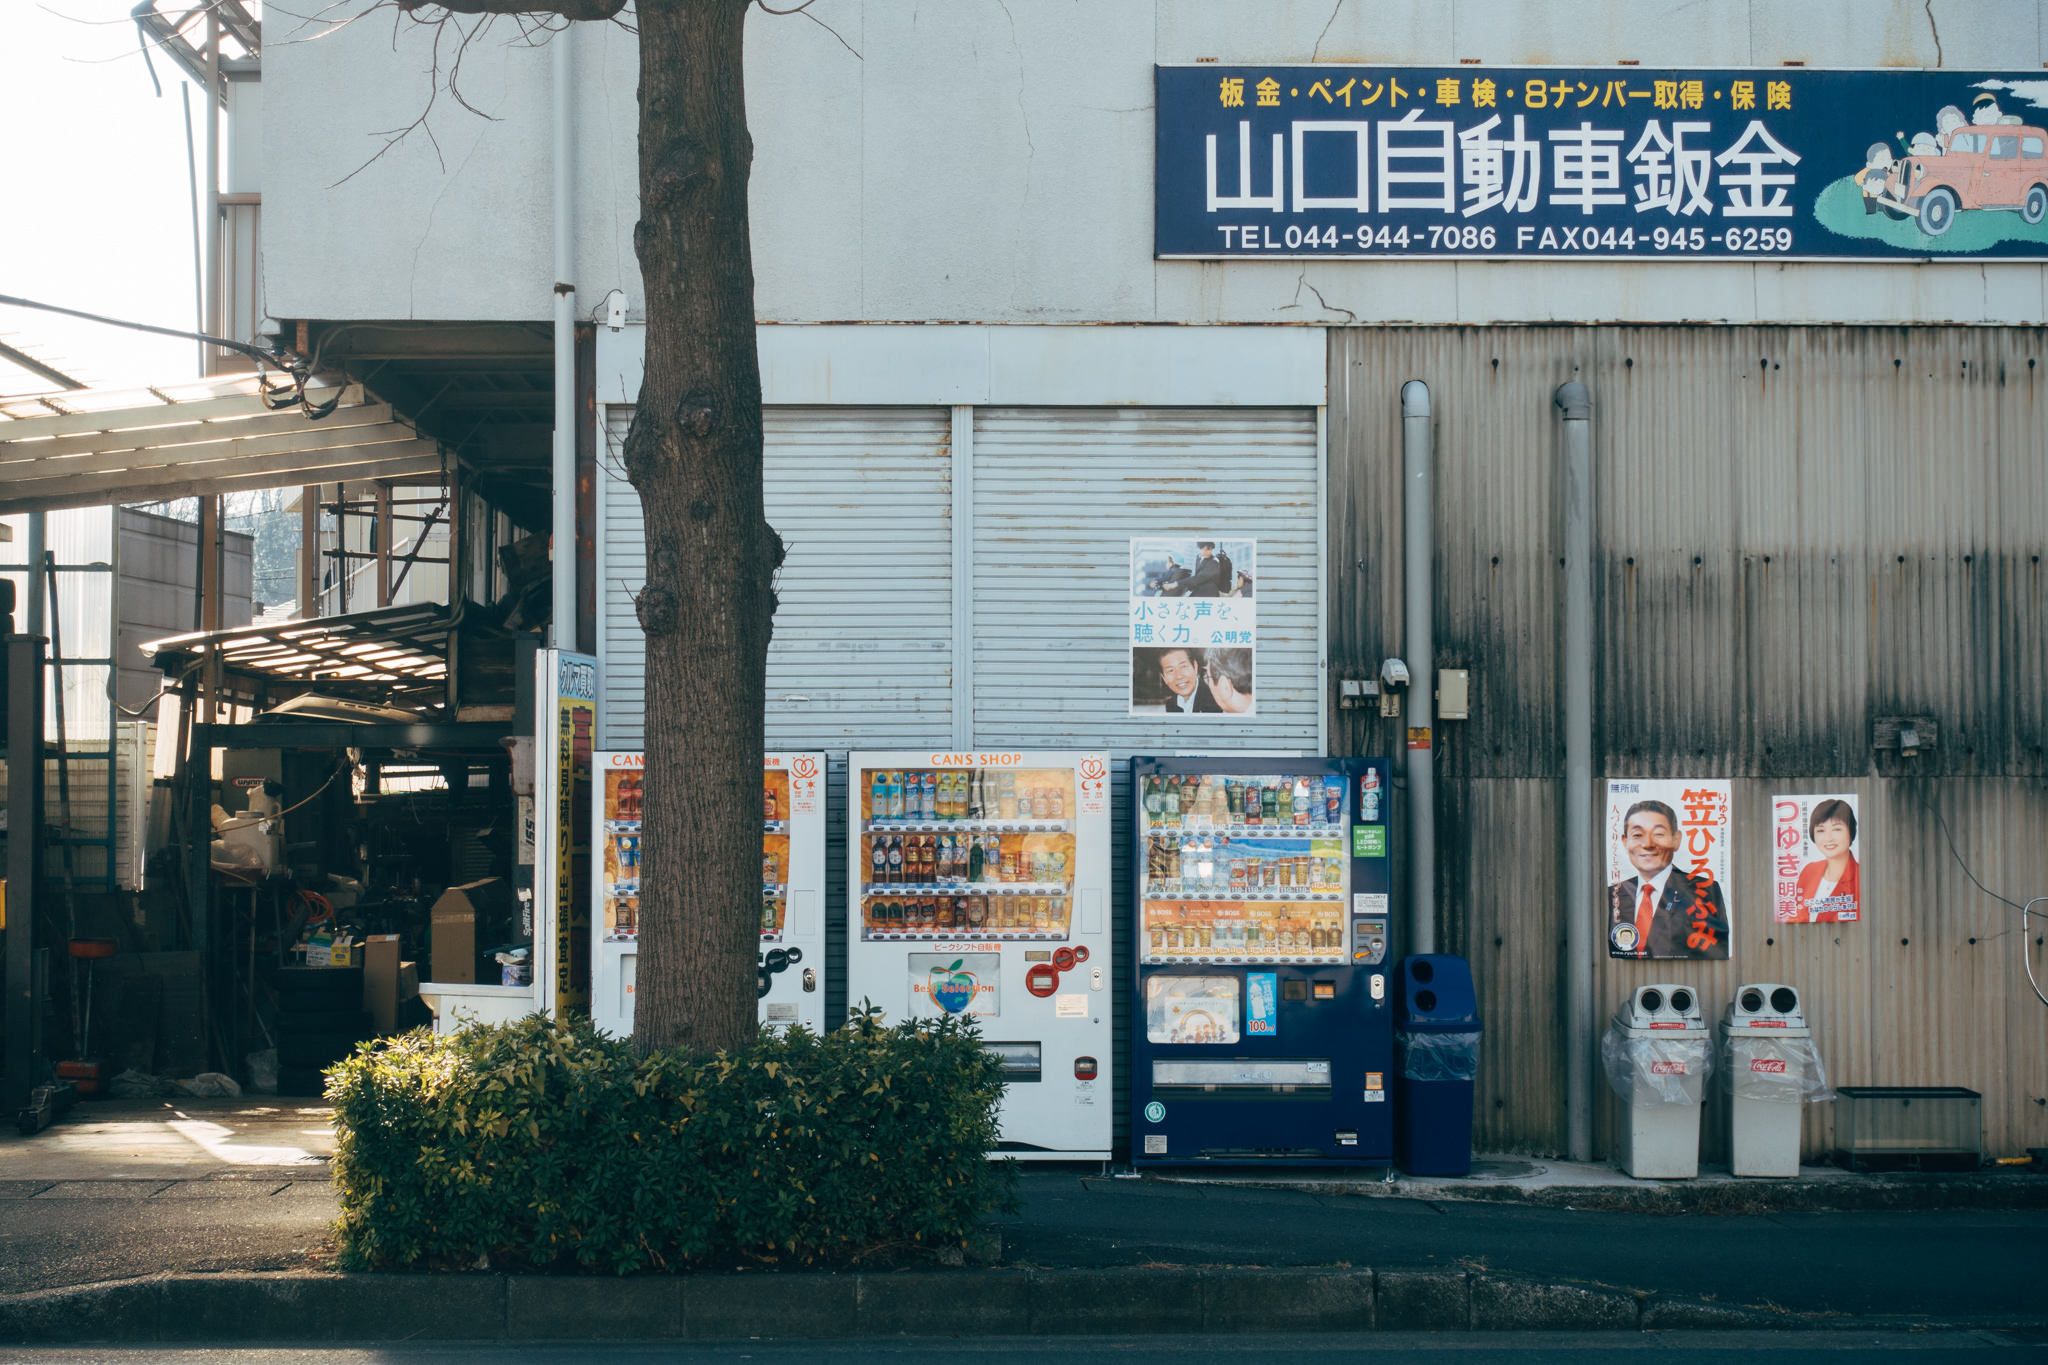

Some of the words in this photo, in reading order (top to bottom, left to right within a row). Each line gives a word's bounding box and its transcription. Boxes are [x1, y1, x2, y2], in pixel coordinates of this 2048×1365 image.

[1205, 108, 1801, 219] 山口自動車鈑金
[1217, 224, 1496, 251] TEL044-944-7086
[1516, 226, 1793, 251] FAX044-945-6259
[1134, 600, 1239, 621] 小さな声を、
[1210, 630, 1252, 644] 公明党
[560, 659, 595, 699] クルマ買取
[611, 754, 645, 766] CAN
[931, 753, 973, 766] CANS
[980, 753, 1022, 766] SHOP
[1610, 783, 1640, 794] 無所属
[1718, 792, 1729, 825] りゅう
[558, 705, 570, 994] 無料見積り・出張査定
[1775, 800, 1800, 917] つゆき明美
[1681, 788, 1718, 952] 笠ひろふみ
[522, 901, 533, 937] SplitFire
[913, 984, 938, 993] Best
[941, 983, 995, 993] Selection
